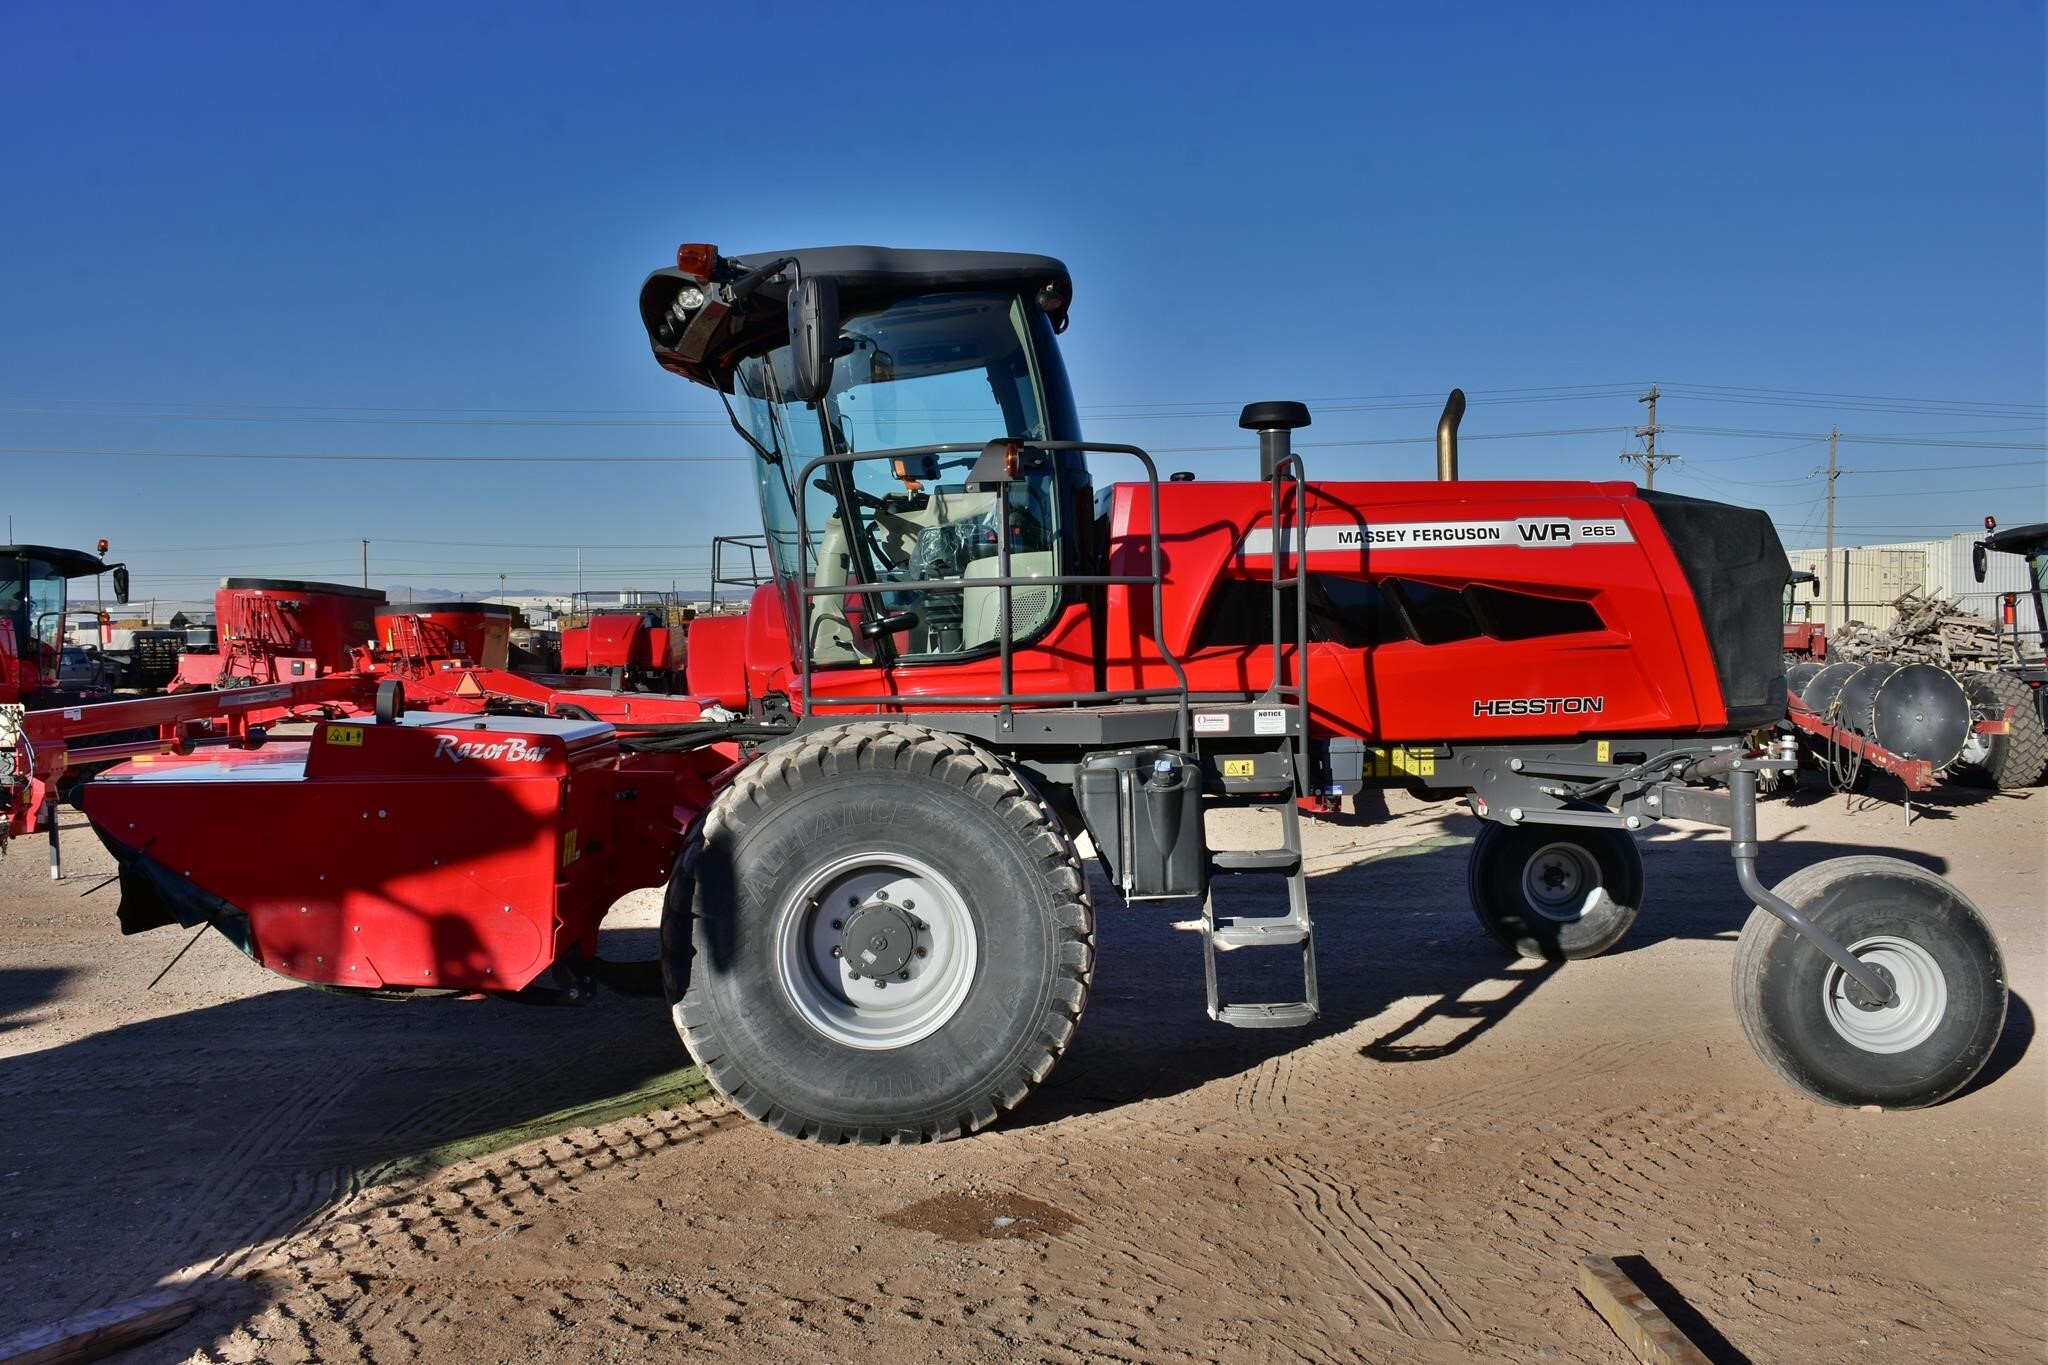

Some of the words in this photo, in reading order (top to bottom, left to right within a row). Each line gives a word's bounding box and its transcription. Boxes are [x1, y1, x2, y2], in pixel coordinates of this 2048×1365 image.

[1338, 529, 1405, 544] MASSEY
[1412, 526, 1501, 542] FERGUSON
[1516, 522, 1572, 541] WR
[1582, 525, 1616, 537] 265
[1473, 696, 1604, 717] HESSTON
[744, 799, 914, 908] ALLIANCE
